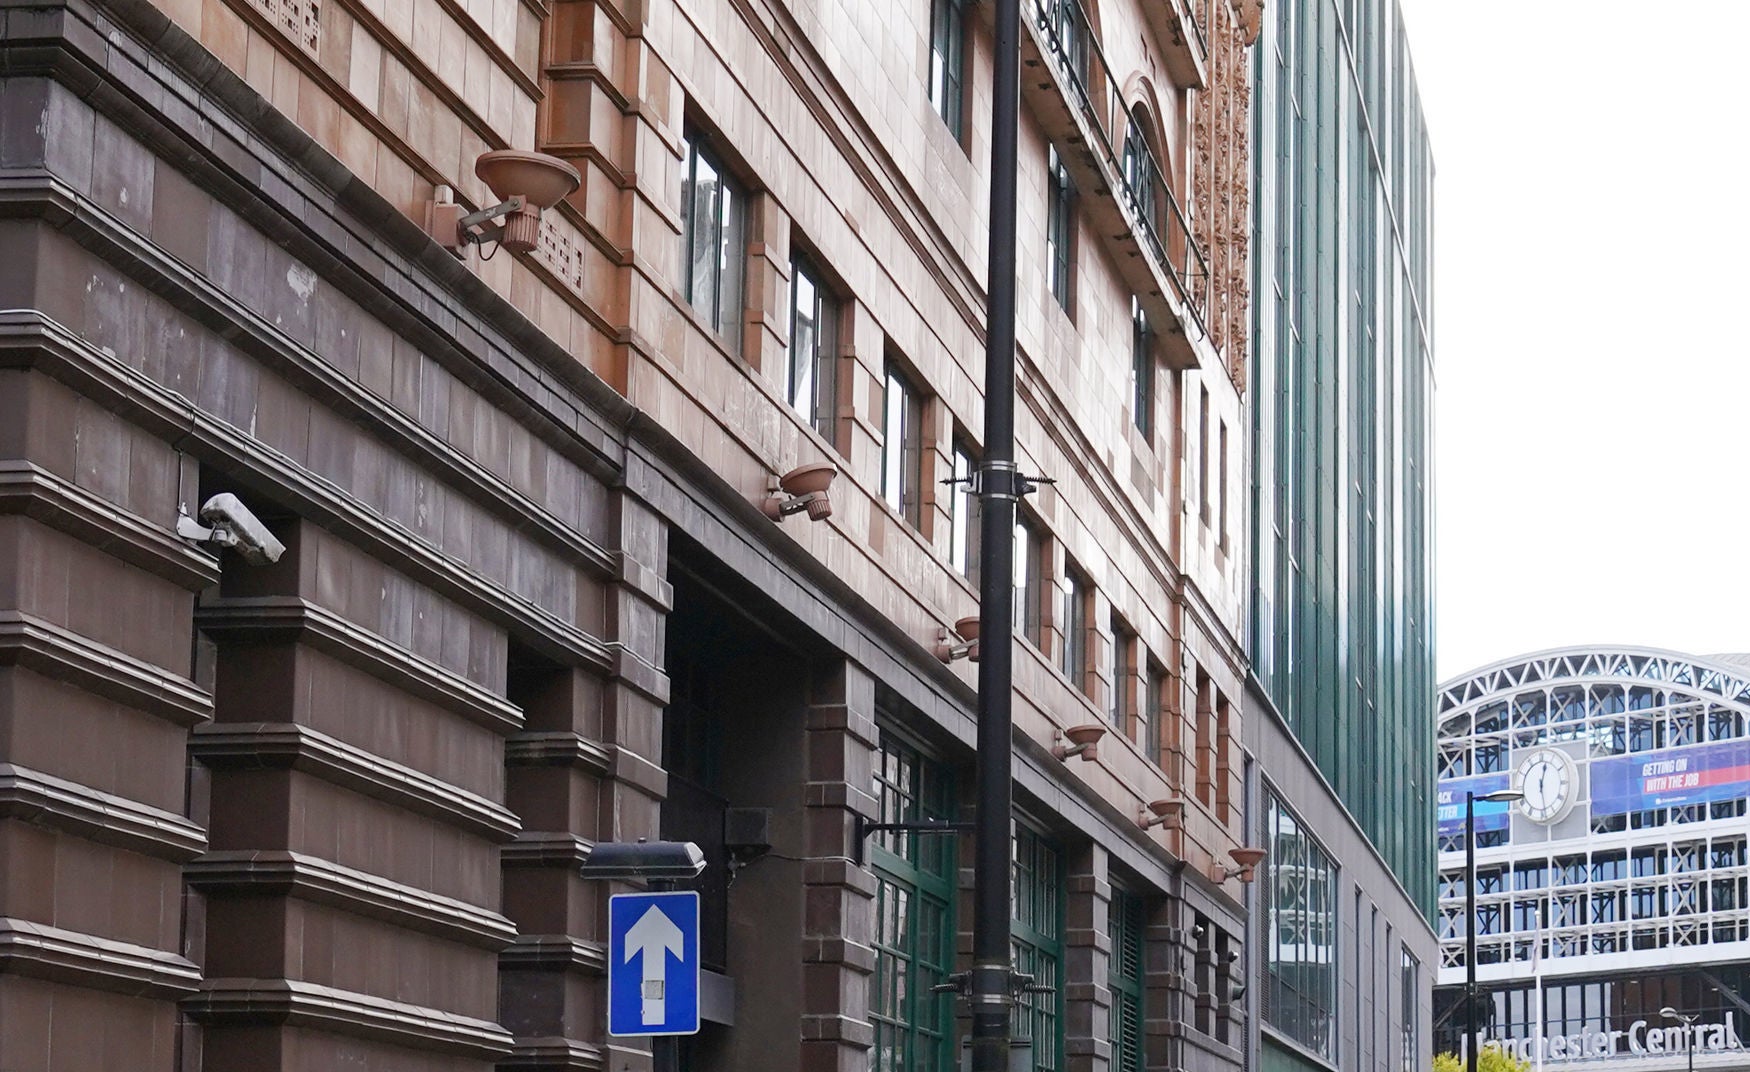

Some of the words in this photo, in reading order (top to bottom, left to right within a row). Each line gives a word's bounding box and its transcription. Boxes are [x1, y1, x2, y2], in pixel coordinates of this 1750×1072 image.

[1642, 760, 1675, 776] GETTING
[1676, 758, 1688, 771] ON
[1646, 777, 1666, 792] WITH
[1668, 775, 1683, 789] THE
[1684, 773, 1699, 787] JOB
[1629, 1011, 1738, 1055] Central
